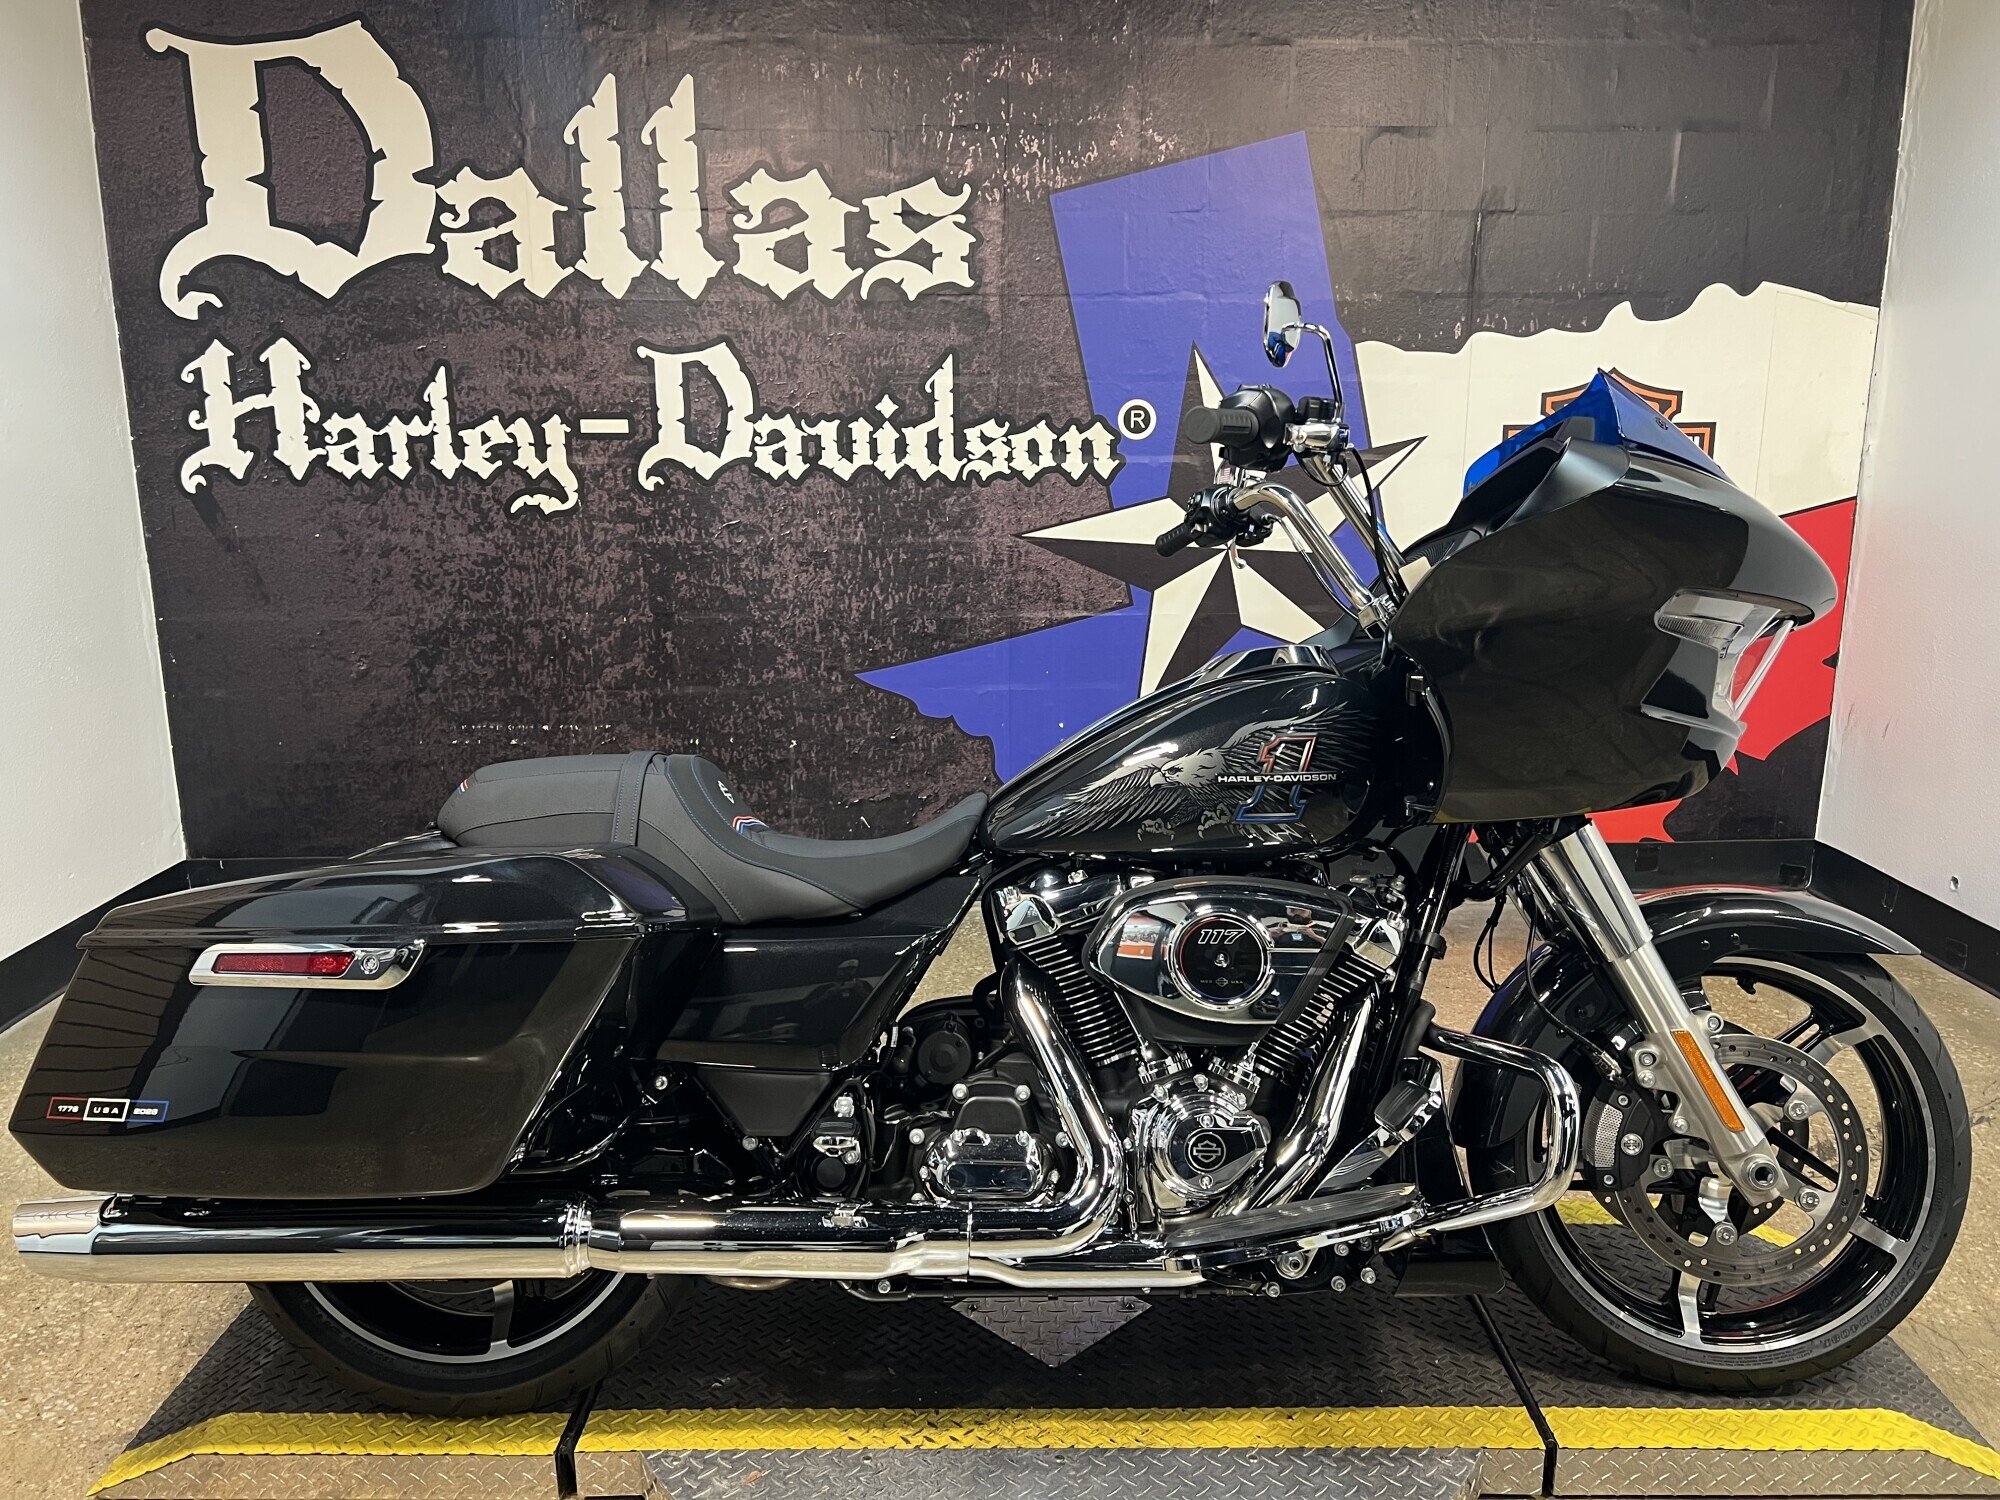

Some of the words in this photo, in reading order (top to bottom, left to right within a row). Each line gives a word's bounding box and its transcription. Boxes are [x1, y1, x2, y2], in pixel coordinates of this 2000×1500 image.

[145, 19, 976, 320] Dallas
[1217, 773, 1337, 783] HARLEY-DAVIDSON
[1197, 929, 1246, 944] 117
[57, 1105, 79, 1113] 1776
